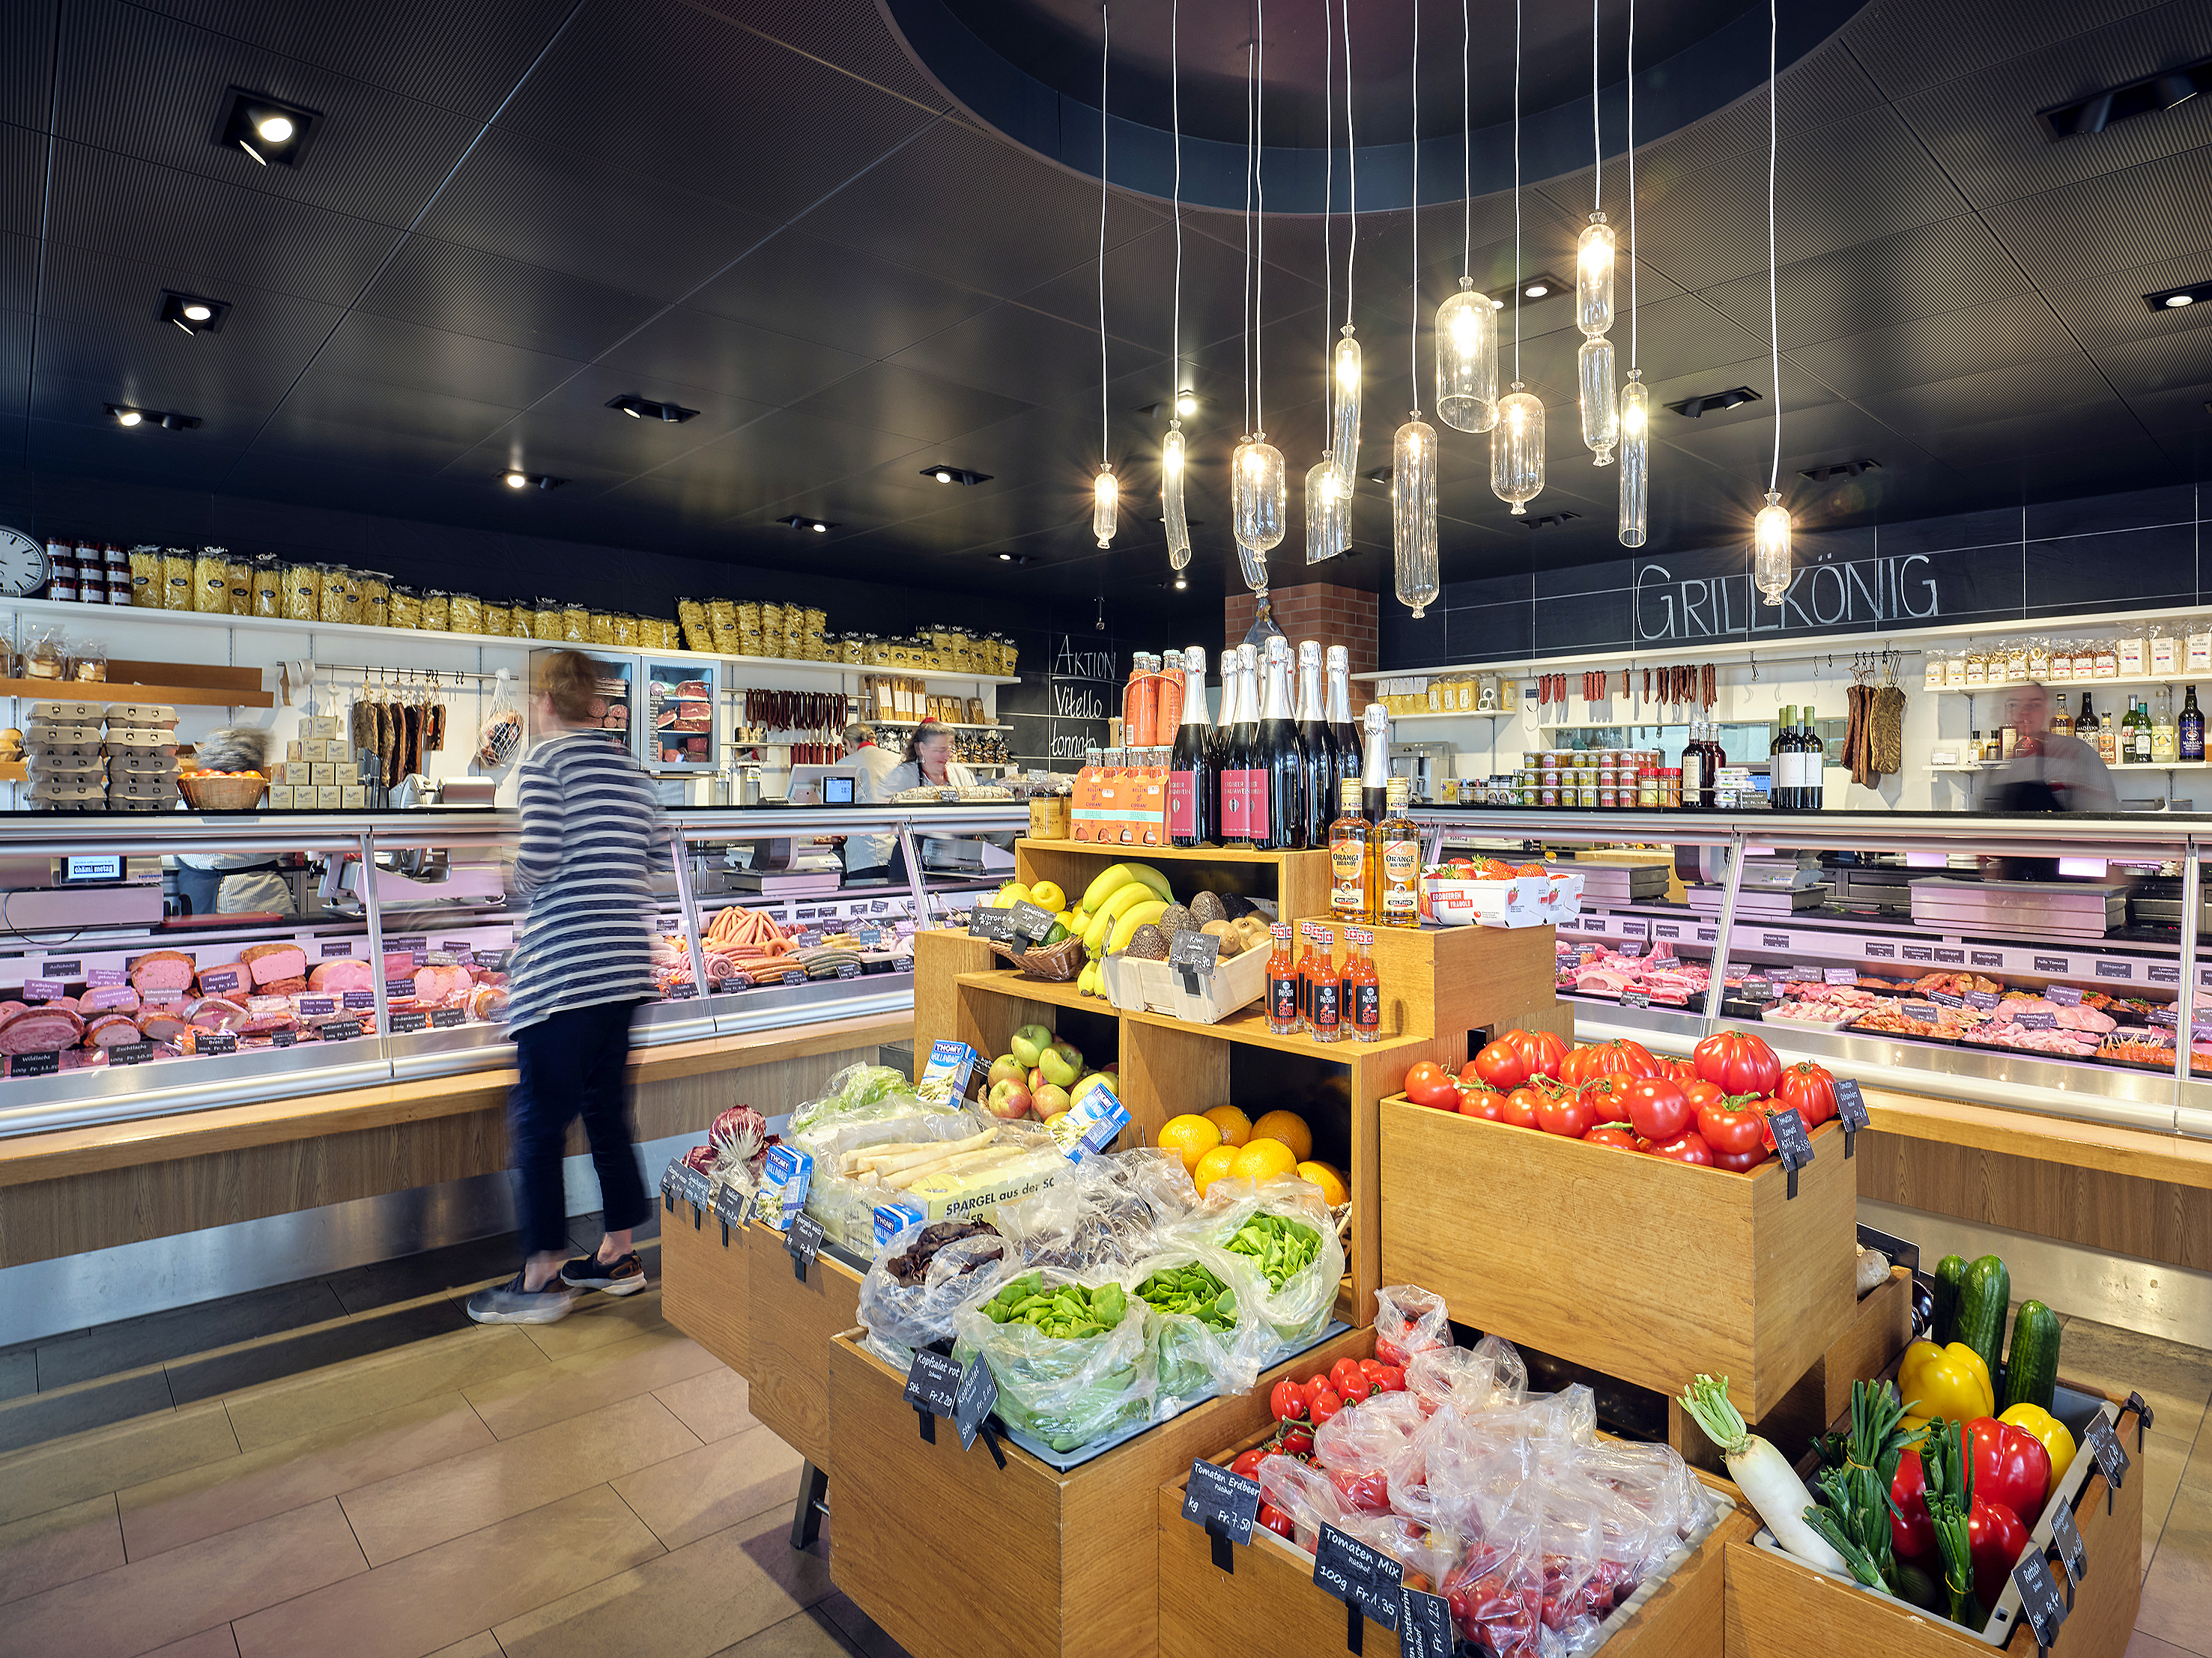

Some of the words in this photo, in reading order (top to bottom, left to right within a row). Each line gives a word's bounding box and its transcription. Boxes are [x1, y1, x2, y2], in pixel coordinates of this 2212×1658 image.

[1636, 553, 1939, 640] GRILLKÖNIG
[1055, 634, 1116, 680] AKTION
[1054, 684, 1103, 719] Vitello
[1432, 891, 1462, 901] ERDBEEREN
[1450, 900, 1471, 908] FRAGOLE
[1190, 935, 1205, 945] Kiwi
[936, 1044, 962, 1054] THOMY
[1094, 1087, 1113, 1109] THOMY
[1776, 1114, 1795, 1126] Tomaten
[770, 1152, 790, 1170] THOMY
[945, 1193, 996, 1216] SPARGEL
[999, 1189, 1019, 1201] aus
[1022, 1182, 1040, 1195] der
[875, 1215, 895, 1232] THOMY
[916, 1352, 948, 1373] Kopfsalat
[948, 1366, 960, 1378] rot
[957, 1364, 980, 1406] Kopfsalat
[1193, 1462, 1227, 1485] Tomaten
[1228, 1477, 1260, 1496] Erdbeer
[1213, 1483, 1234, 1496] Rütihof
[1187, 1496, 1199, 1513] kg
[1324, 1528, 1374, 1565] Tomaten
[1377, 1558, 1400, 1579] Mix
[1348, 1556, 1371, 1573] Rütihof
[1319, 1565, 1348, 1592] 100g
[2022, 1559, 2042, 1585] Rettich
[1401, 1587, 1414, 1643] Datterini
[1413, 1626, 1424, 1658] ütihof
